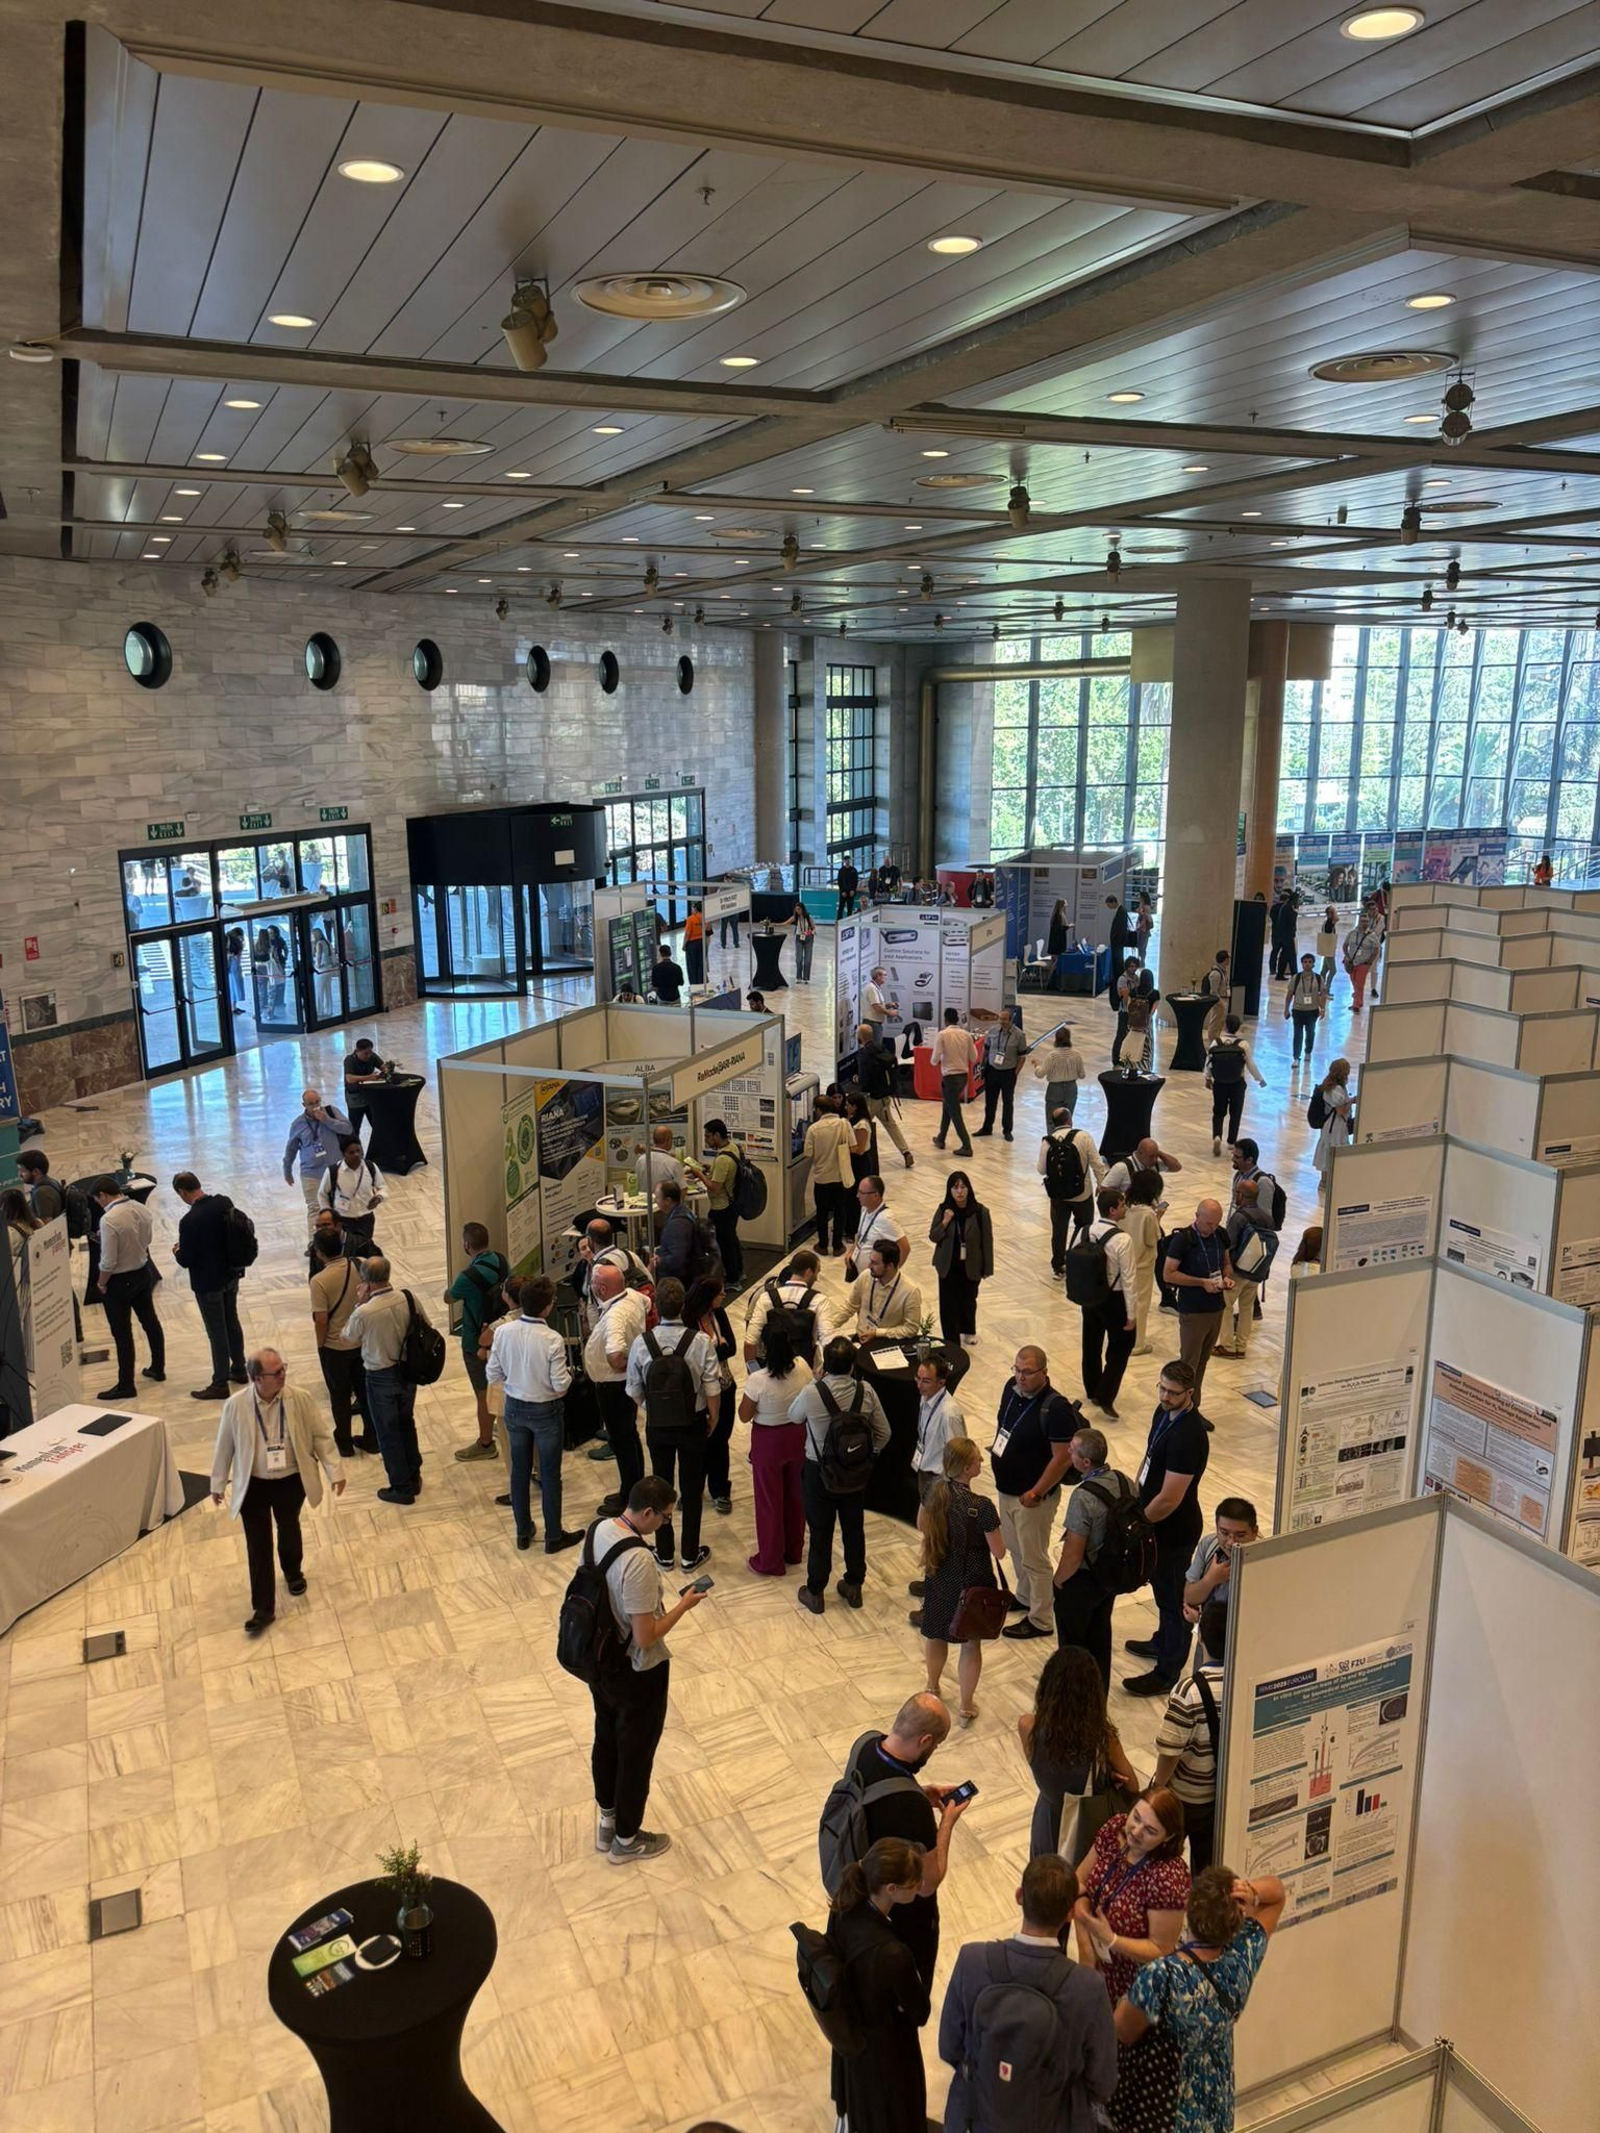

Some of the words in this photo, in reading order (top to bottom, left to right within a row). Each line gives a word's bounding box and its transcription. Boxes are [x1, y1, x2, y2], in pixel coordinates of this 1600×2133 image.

[635, 1064, 656, 1072] ALBA
[541, 1108, 565, 1122] RIANA
[12, 1445, 68, 1474] Momentum
